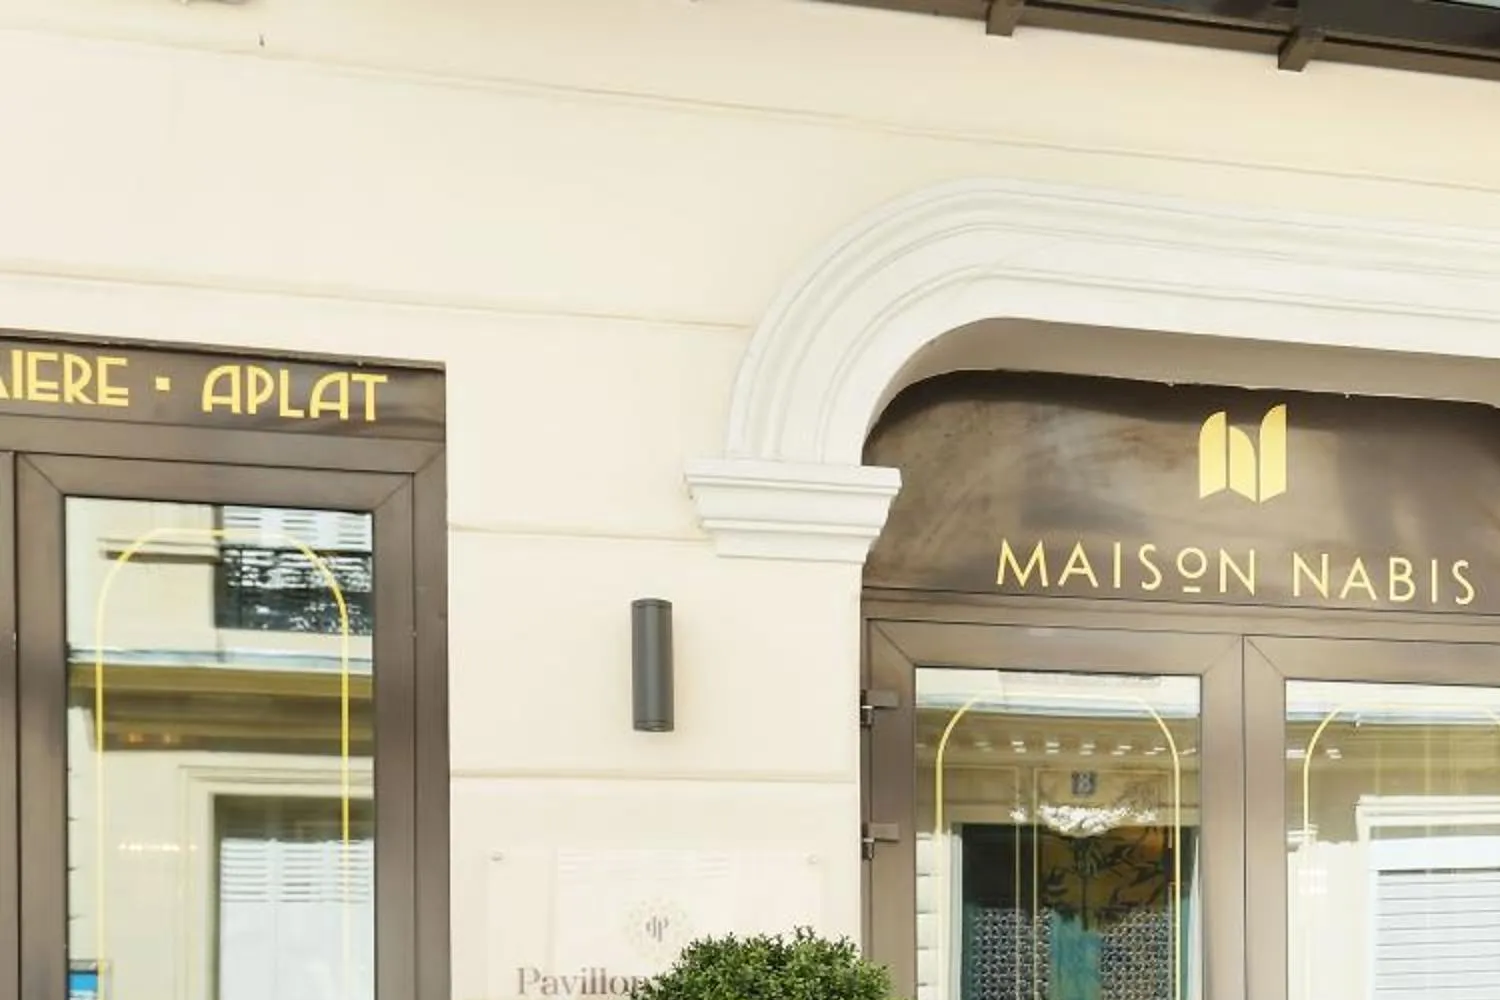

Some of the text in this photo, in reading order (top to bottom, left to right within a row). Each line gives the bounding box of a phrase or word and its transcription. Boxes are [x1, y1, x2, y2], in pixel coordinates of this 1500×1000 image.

[0, 349, 388, 422] IERE APLAT
[996, 539, 1477, 605] MAISON NABIS
